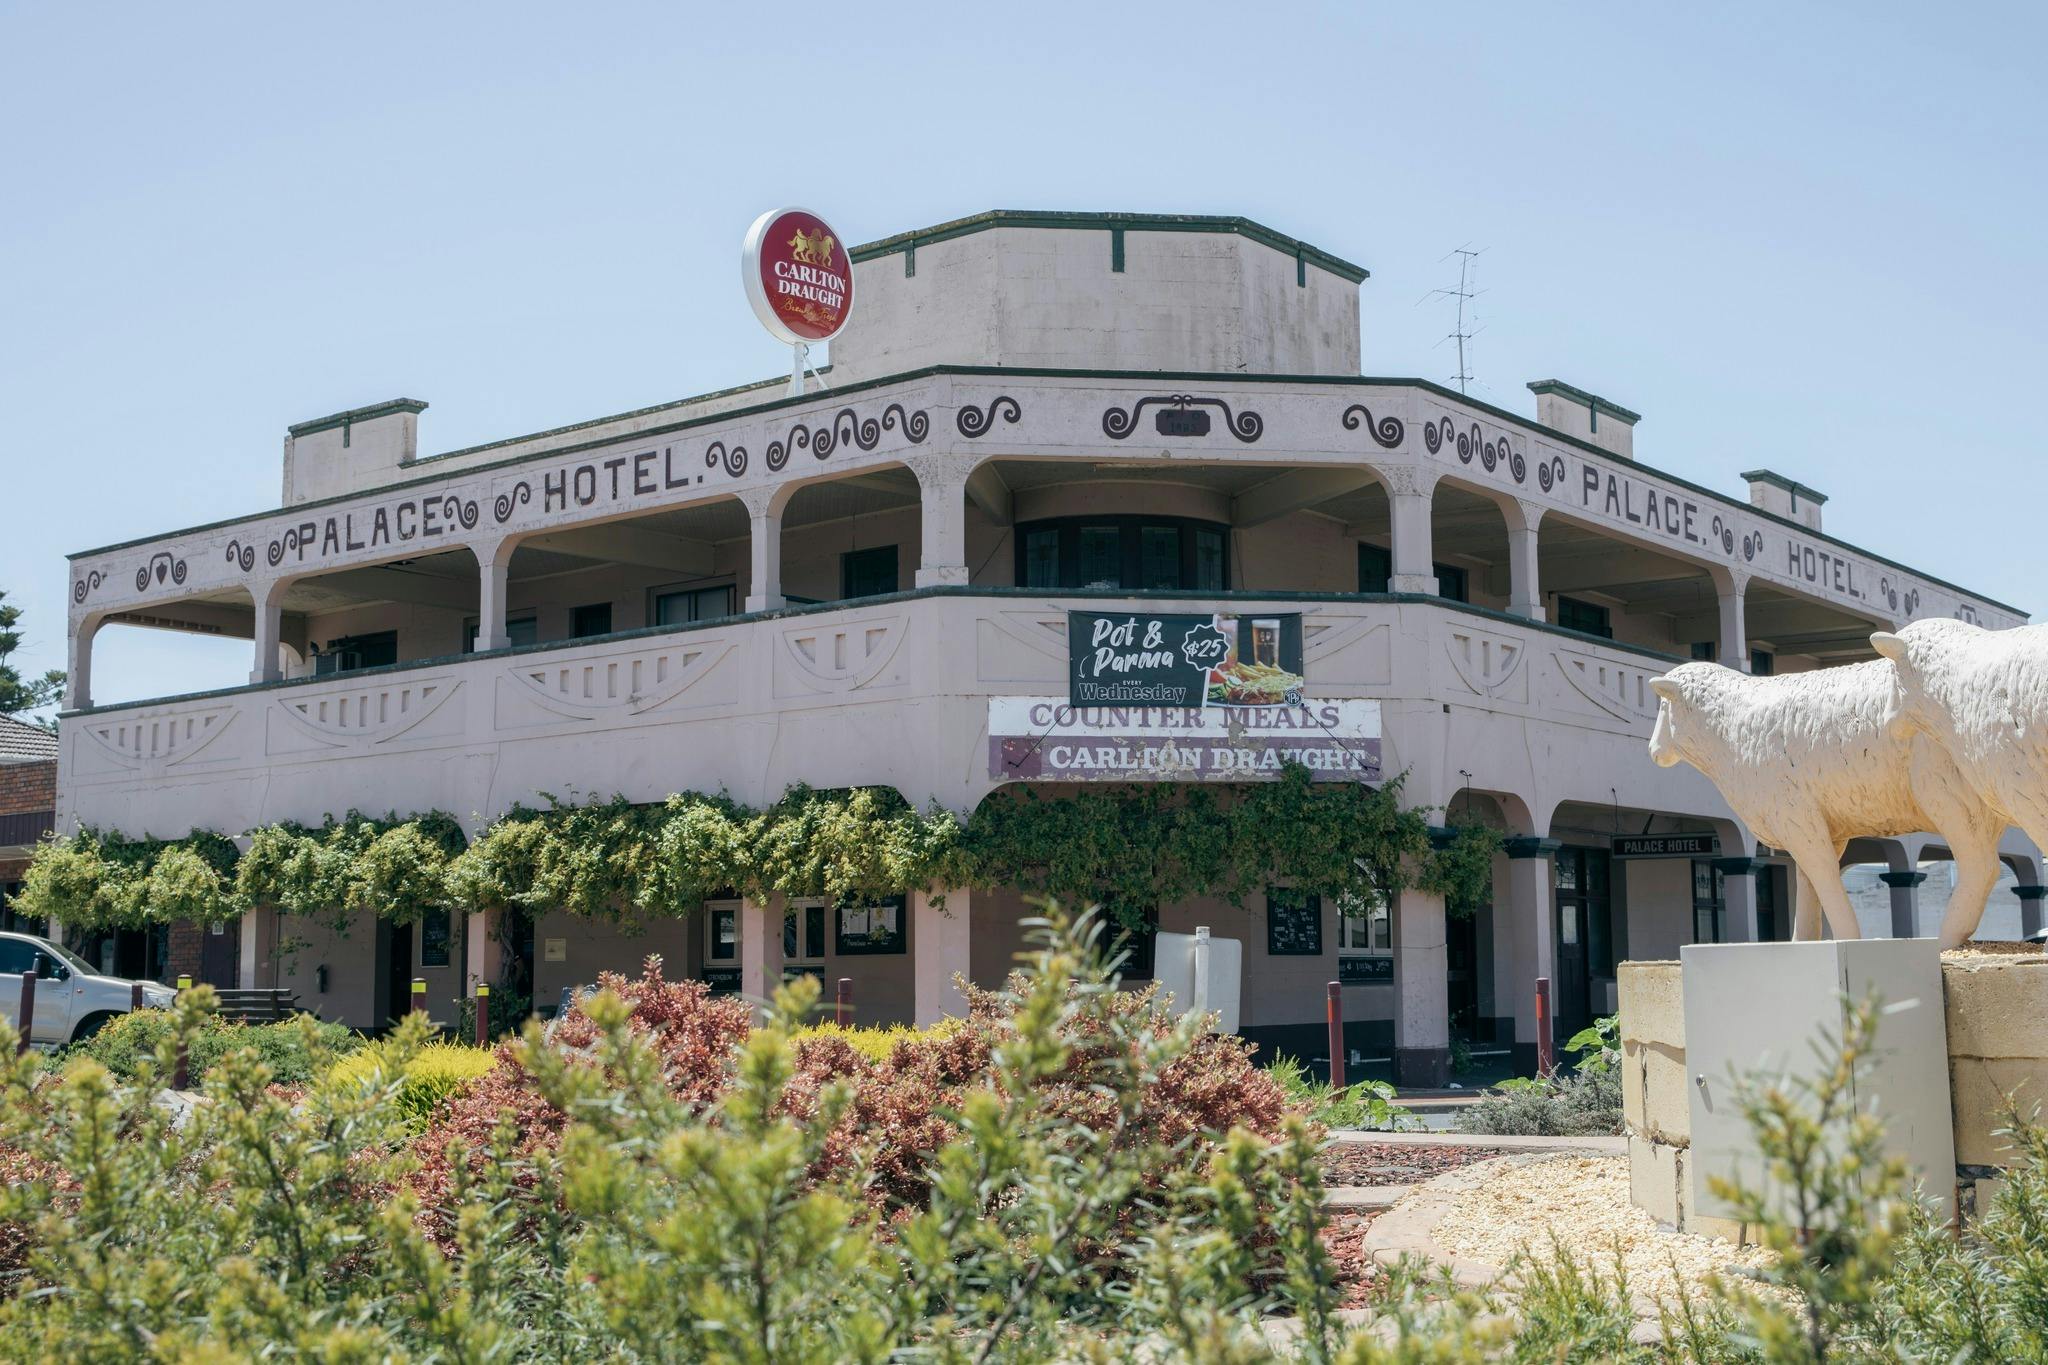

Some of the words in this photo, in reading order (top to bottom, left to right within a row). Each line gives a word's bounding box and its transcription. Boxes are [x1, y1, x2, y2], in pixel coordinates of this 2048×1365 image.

[774, 261, 846, 294] CARLTON
[778, 280, 843, 309] DRAUGHT
[298, 495, 456, 561] PALACE.
[544, 448, 704, 513] HOTEL.
[1582, 463, 1707, 546] PALACE.
[1787, 540, 1866, 601] HOTEL.
[1091, 617, 1140, 648] Pot
[1142, 620, 1164, 649] &
[1093, 646, 1175, 677] Parma
[1186, 639, 1223, 658] $25
[1078, 682, 1187, 704] Wednesday
[1122, 679, 1143, 687] EVERY
[1029, 703, 1206, 729] COUNTER
[1219, 705, 1341, 730] MEALS
[1049, 745, 1204, 770] CARLTON
[1624, 840, 1665, 854] PALACE
[1667, 839, 1702, 852] HOTEL
